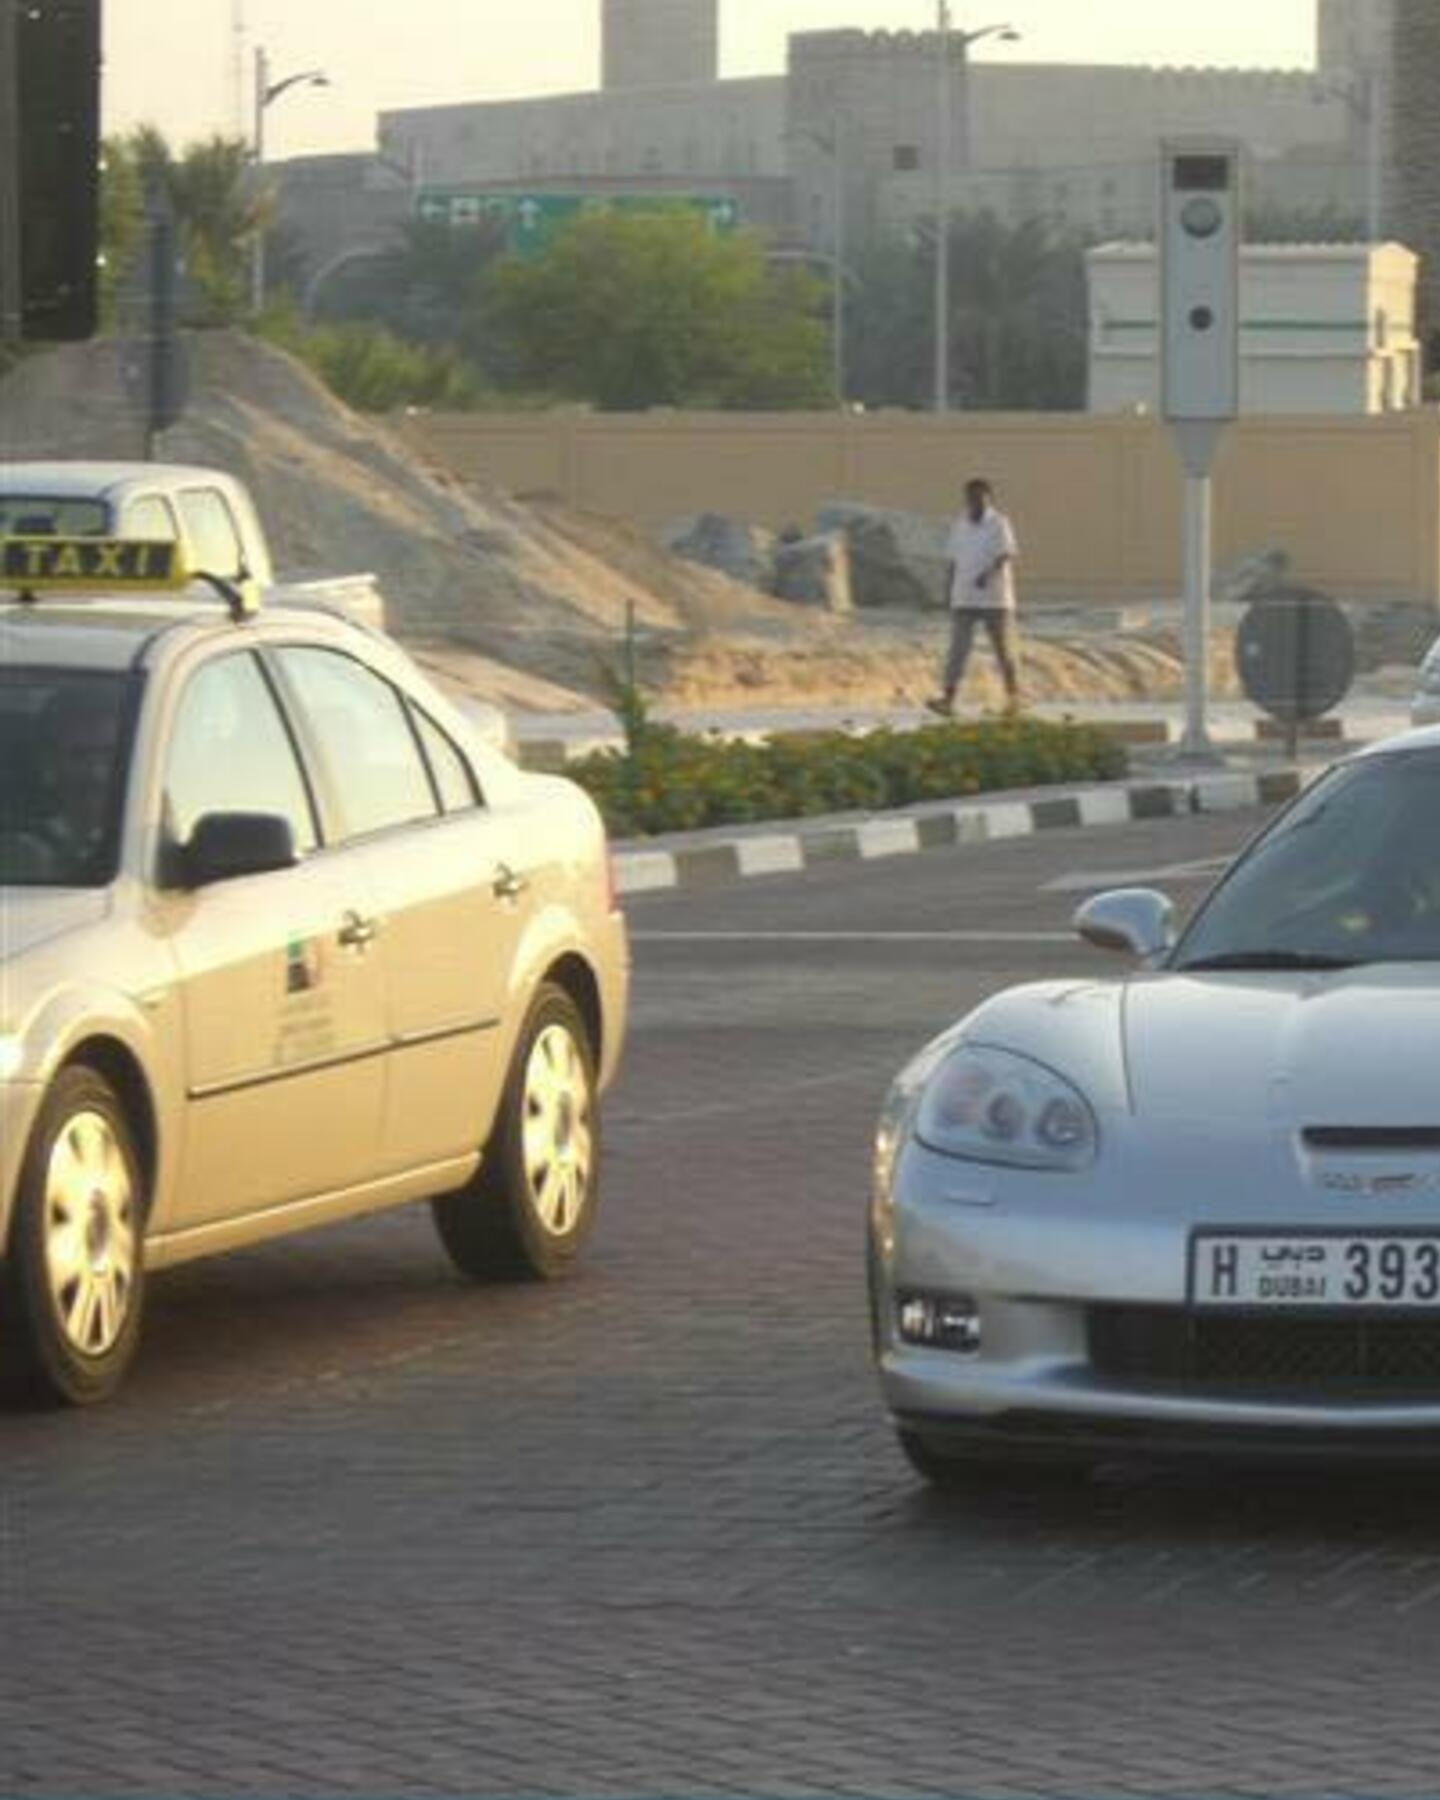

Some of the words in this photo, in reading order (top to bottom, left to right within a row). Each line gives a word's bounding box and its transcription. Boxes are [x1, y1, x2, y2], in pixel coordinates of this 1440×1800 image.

[24, 541, 150, 577] TAXI
[1211, 1244, 1239, 1297] H
[1258, 1276, 1327, 1298] DUBAI
